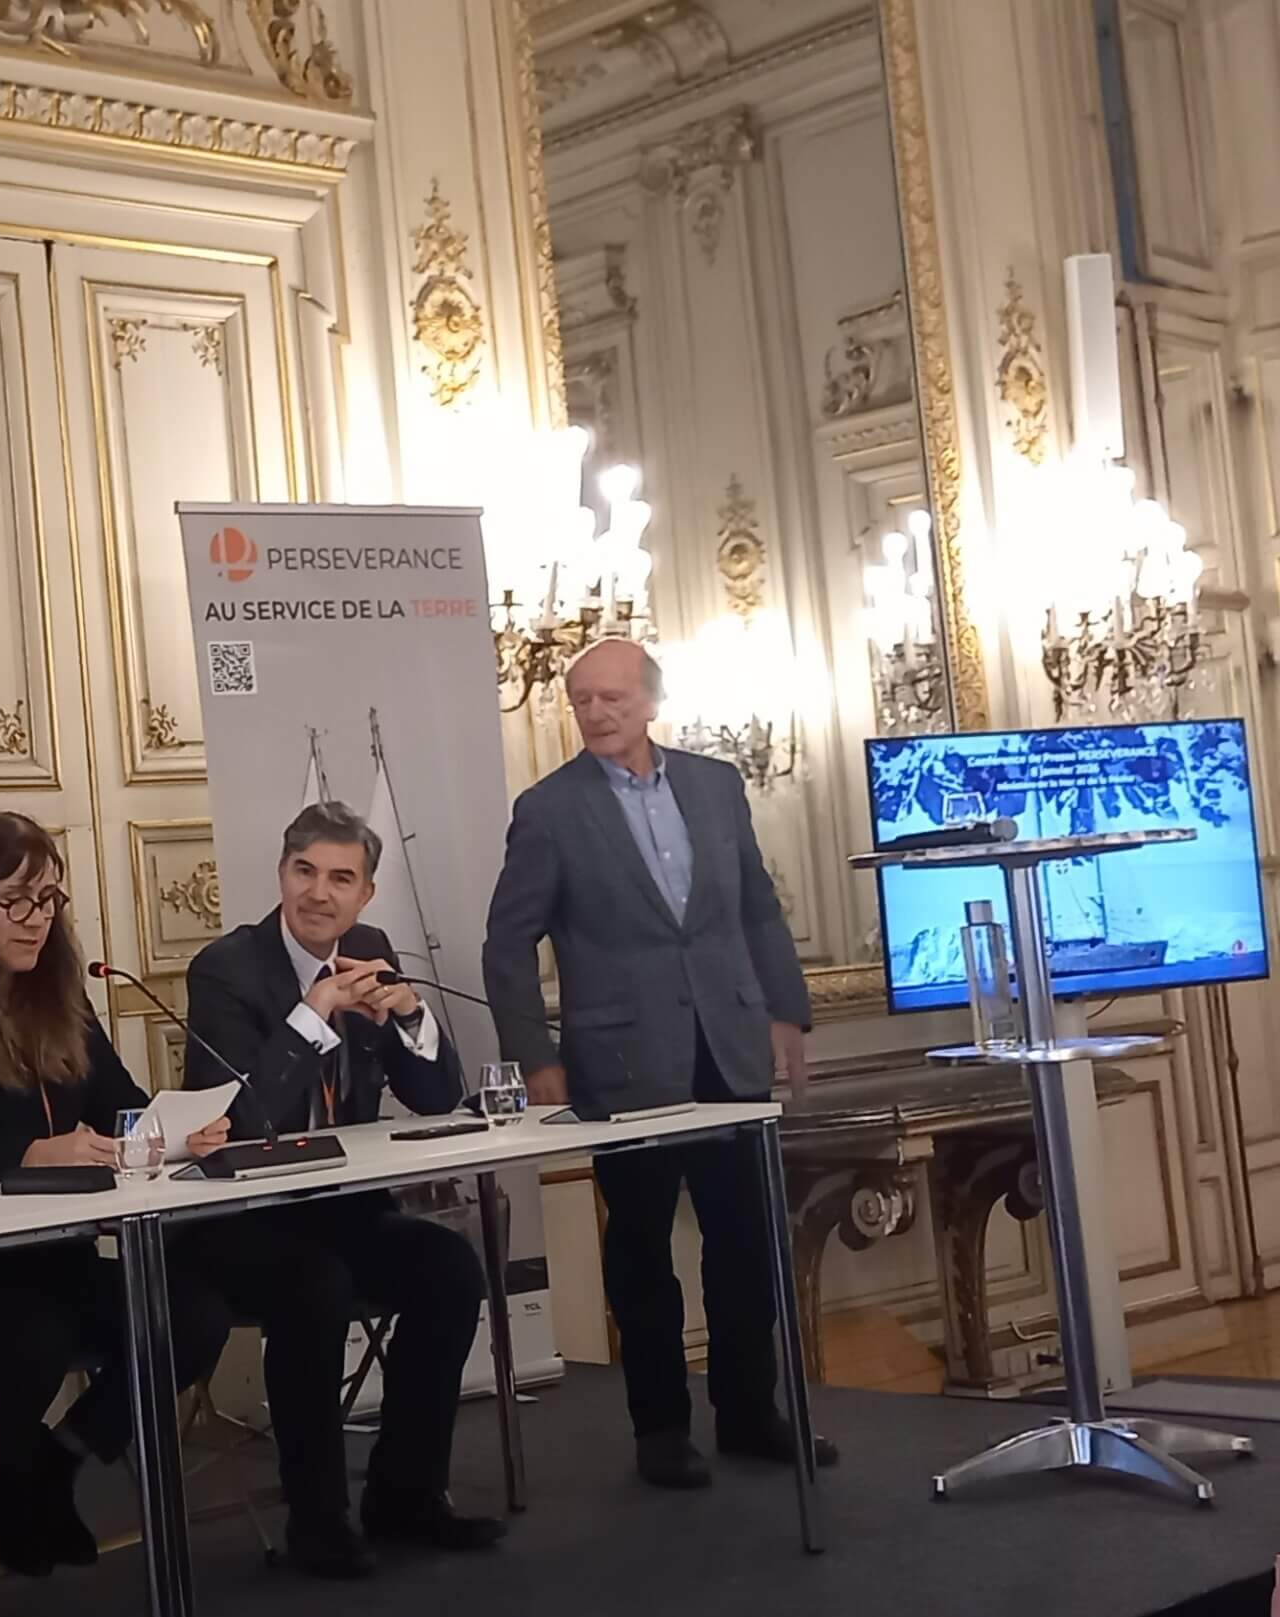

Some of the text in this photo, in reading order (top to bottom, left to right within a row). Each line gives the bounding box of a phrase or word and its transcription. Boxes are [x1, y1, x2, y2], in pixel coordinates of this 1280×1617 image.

[266, 547, 463, 570] PERSEVERANCE
[205, 599, 478, 621] AU SERVICE DE LA TERRE
